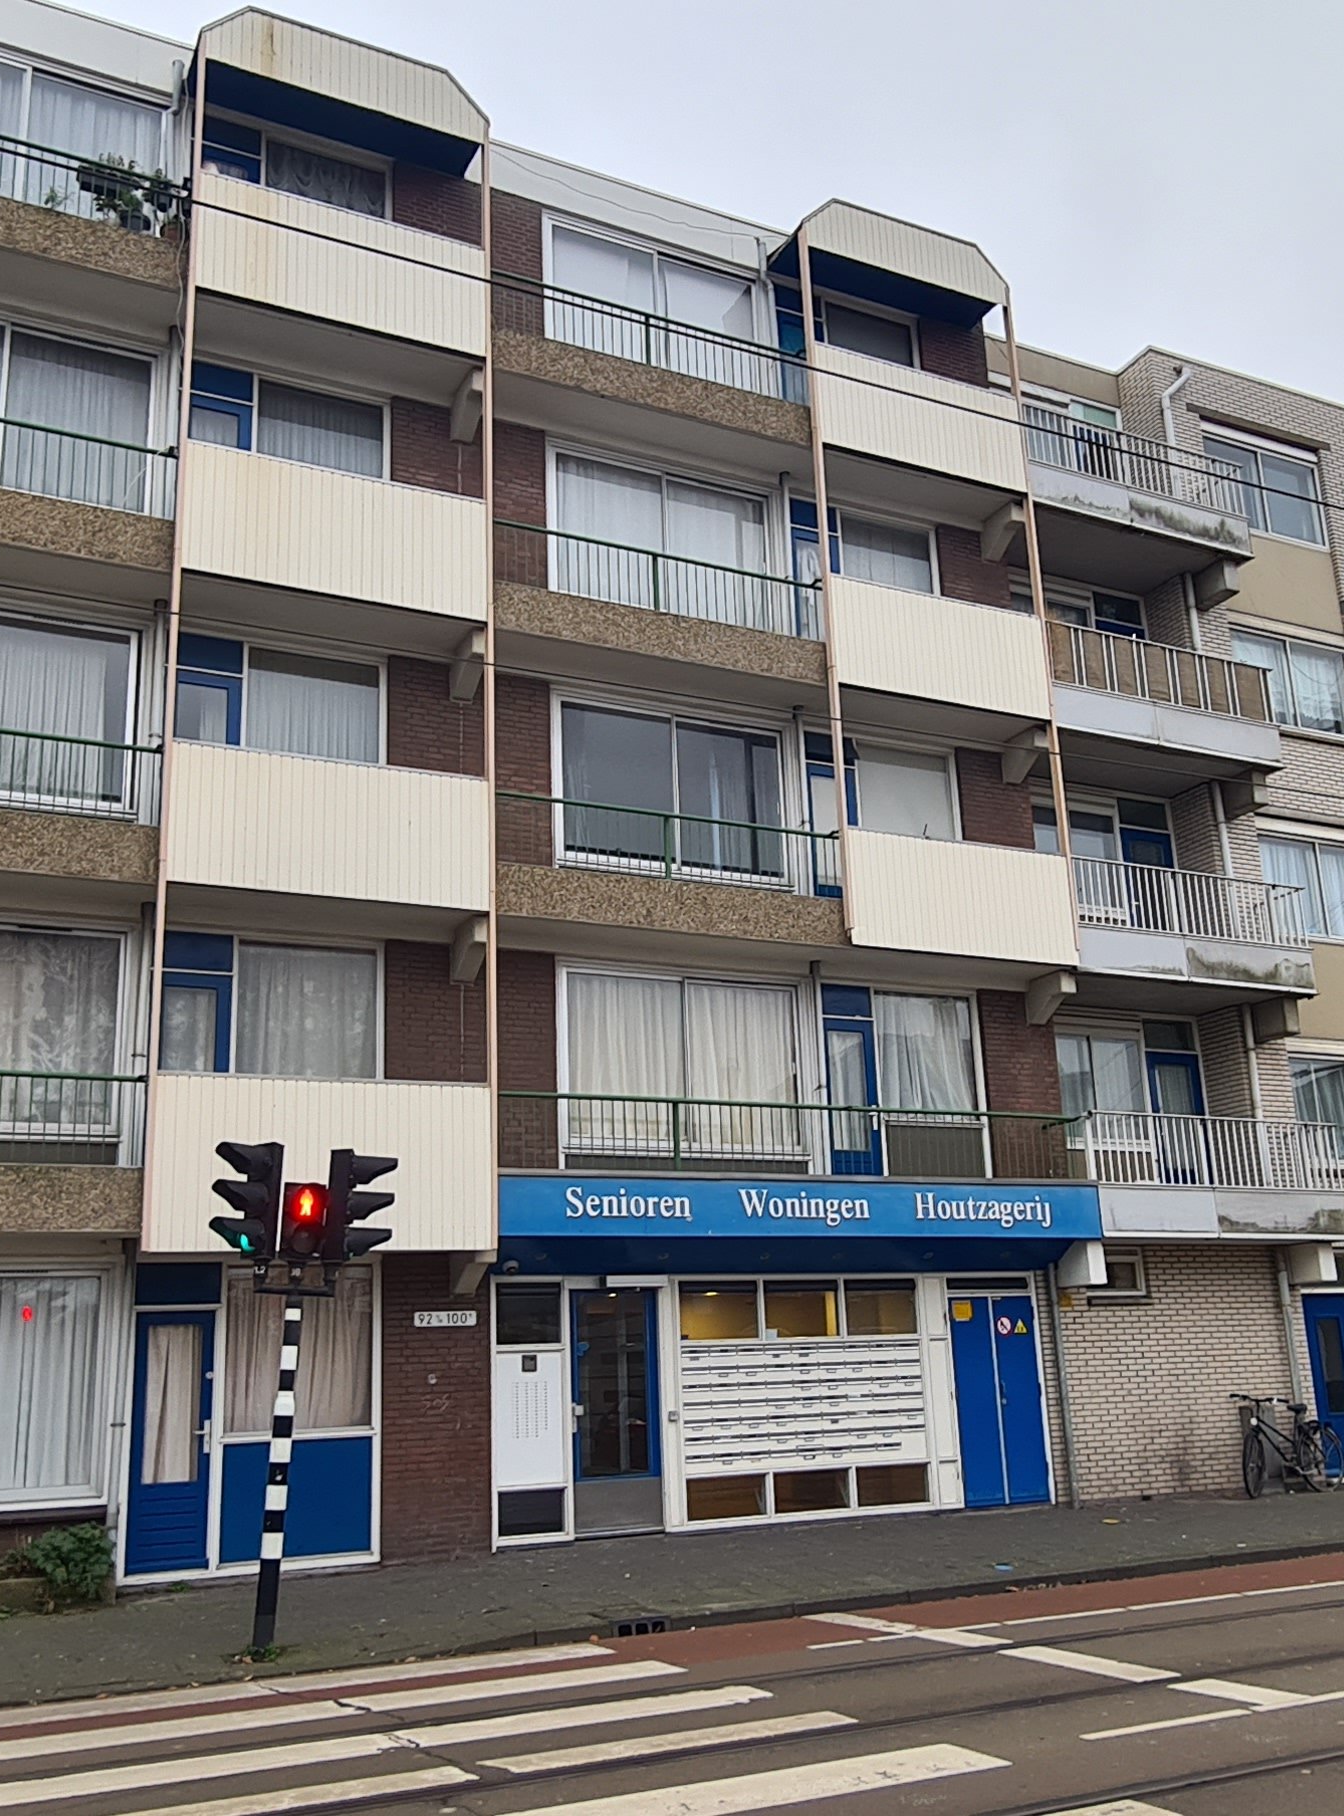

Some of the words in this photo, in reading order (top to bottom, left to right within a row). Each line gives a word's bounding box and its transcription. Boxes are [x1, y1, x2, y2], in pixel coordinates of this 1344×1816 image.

[565, 1186, 691, 1218] Senioren
[737, 1188, 871, 1227] Woningen
[915, 1191, 1052, 1229] Houtzagerij
[418, 1313, 433, 1325] 92
